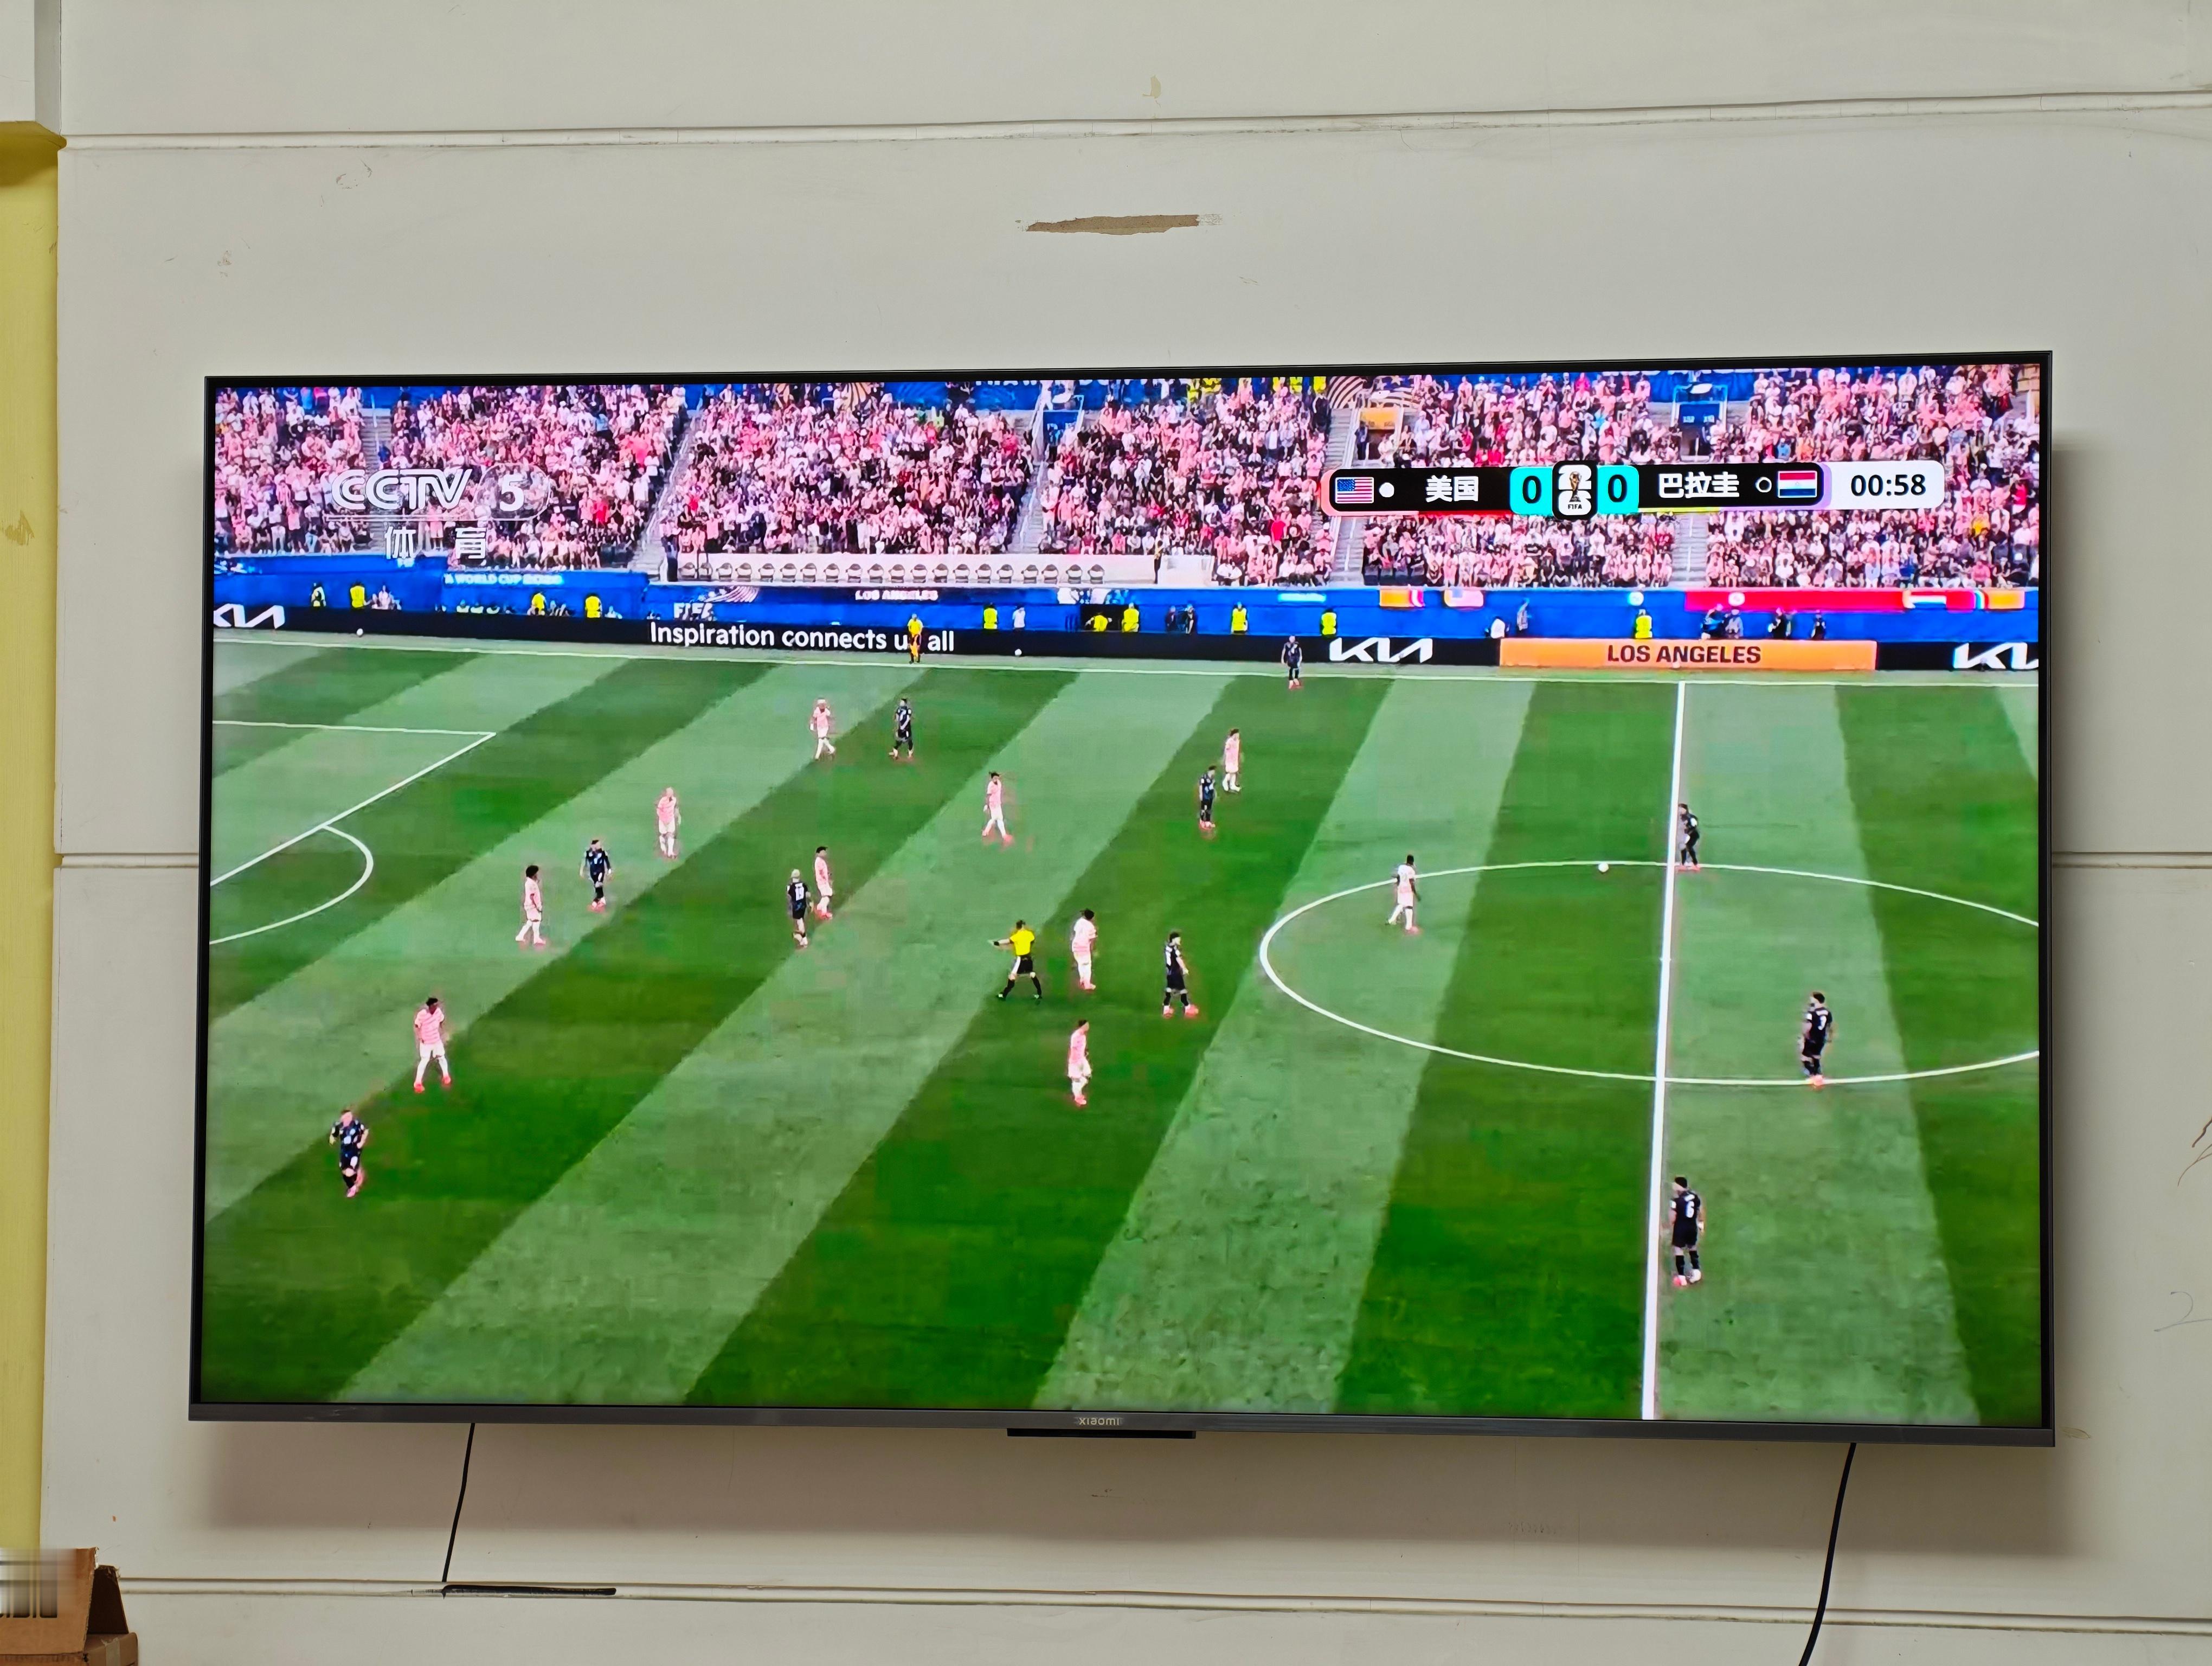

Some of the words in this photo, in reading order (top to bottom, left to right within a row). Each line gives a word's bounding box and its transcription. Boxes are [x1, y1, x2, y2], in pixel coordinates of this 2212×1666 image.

[332, 469, 472, 510] CCTV
[499, 474, 525, 511] 5
[1425, 475, 1479, 503] 美国
[1522, 475, 1542, 504] 0
[1607, 474, 1627, 503] 0
[1658, 471, 1740, 498] 巴拉圭
[1850, 474, 1926, 497] 00:58
[384, 526, 486, 560] 体育
[855, 589, 880, 600] LOS
[651, 621, 775, 647] Inspiration
[782, 629, 887, 650] connects
[927, 630, 954, 651] all
[1329, 637, 1433, 663] KIA
[1607, 645, 1650, 662] LOS
[1656, 645, 1761, 663] ANGELES
[1079, 1417, 1120, 1426] xiaomi
